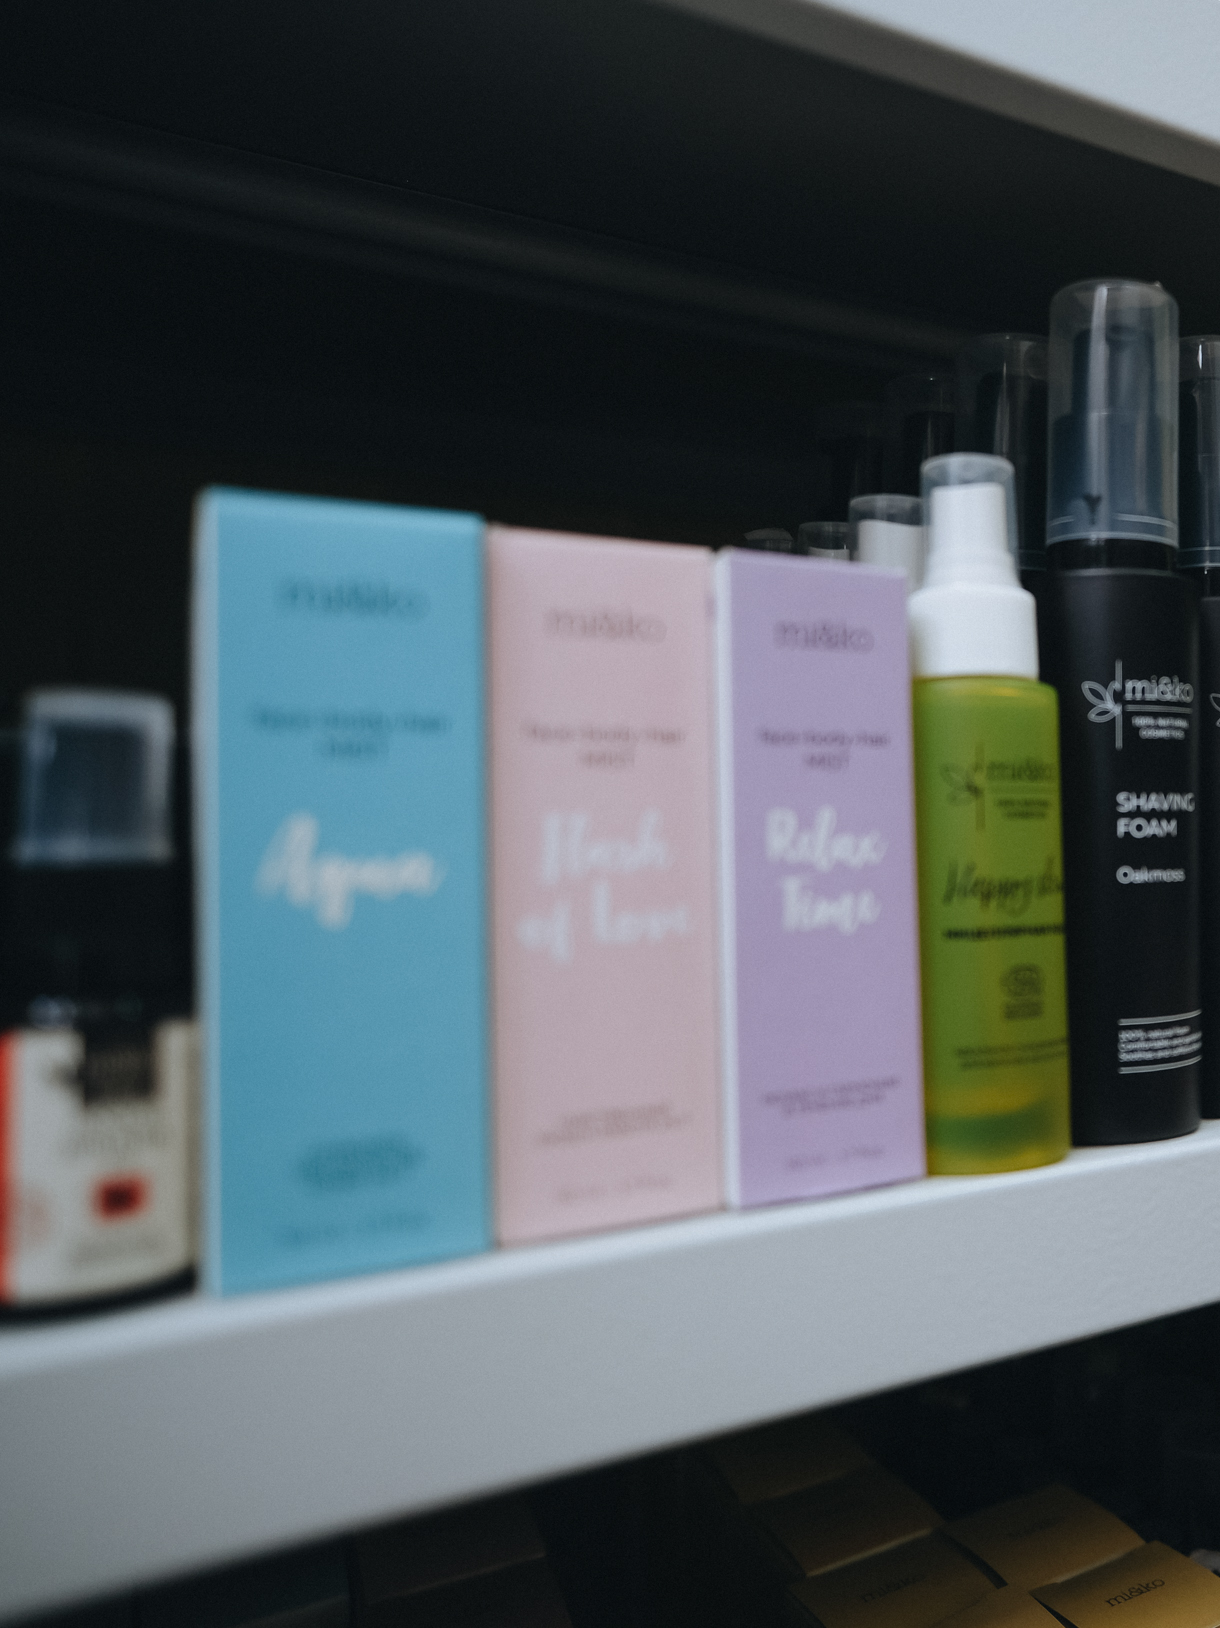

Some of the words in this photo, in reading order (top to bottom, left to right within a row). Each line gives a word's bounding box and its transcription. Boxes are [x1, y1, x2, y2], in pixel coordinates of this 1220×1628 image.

[1124, 675, 1194, 704] mi&ko
[1116, 791, 1196, 813] SHAVING
[765, 804, 889, 874] Relax
[1116, 817, 1178, 839] FOAM
[780, 873, 882, 936] Time
[1105, 1578, 1166, 1608] mi&ko
